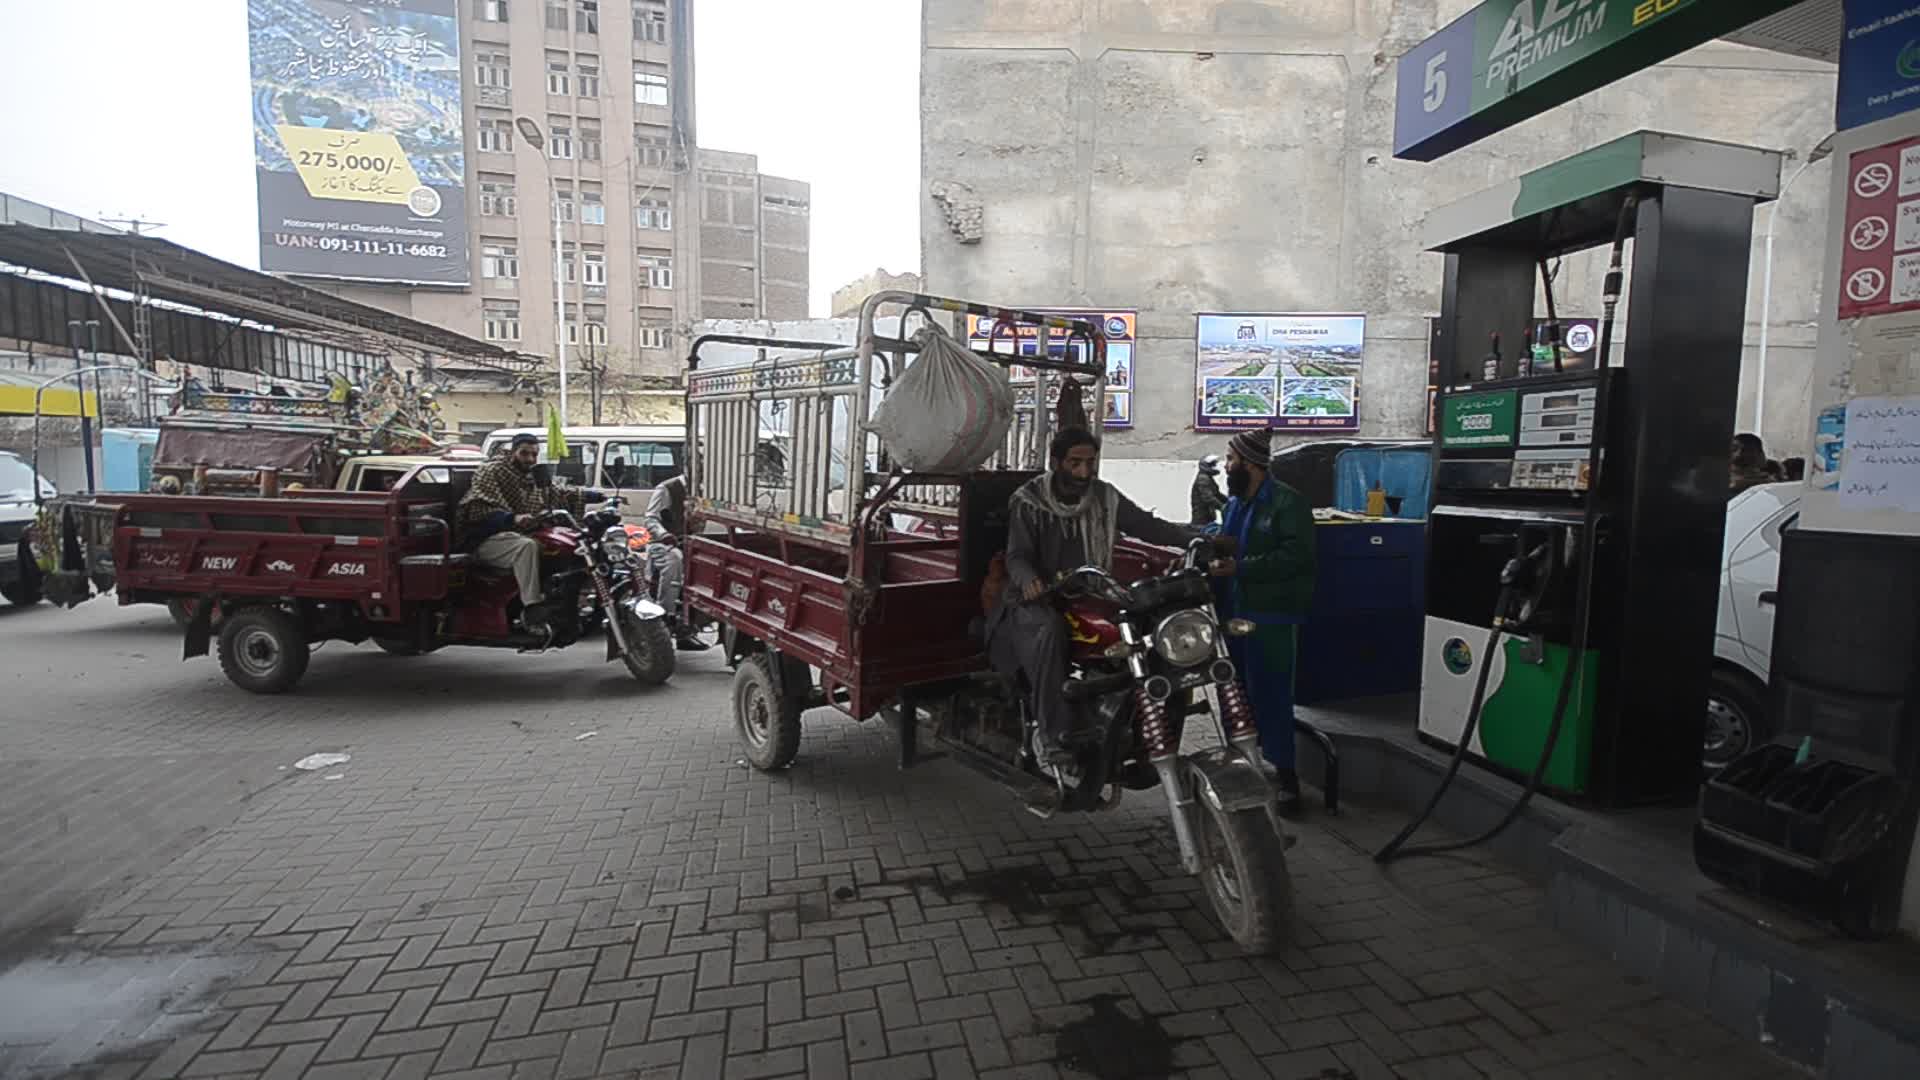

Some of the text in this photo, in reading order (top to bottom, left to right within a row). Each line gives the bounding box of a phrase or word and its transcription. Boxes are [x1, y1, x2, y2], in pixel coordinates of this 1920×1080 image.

[1488, 0, 1593, 61] AL
[1485, 1, 1608, 89] PREMIUM
[1423, 50, 1449, 113] 5
[327, 135, 361, 151] صرف
[299, 150, 402, 175] 275,000/-
[202, 557, 238, 570] NEW
[327, 562, 366, 576] ASIA
[730, 581, 749, 600] NEW
